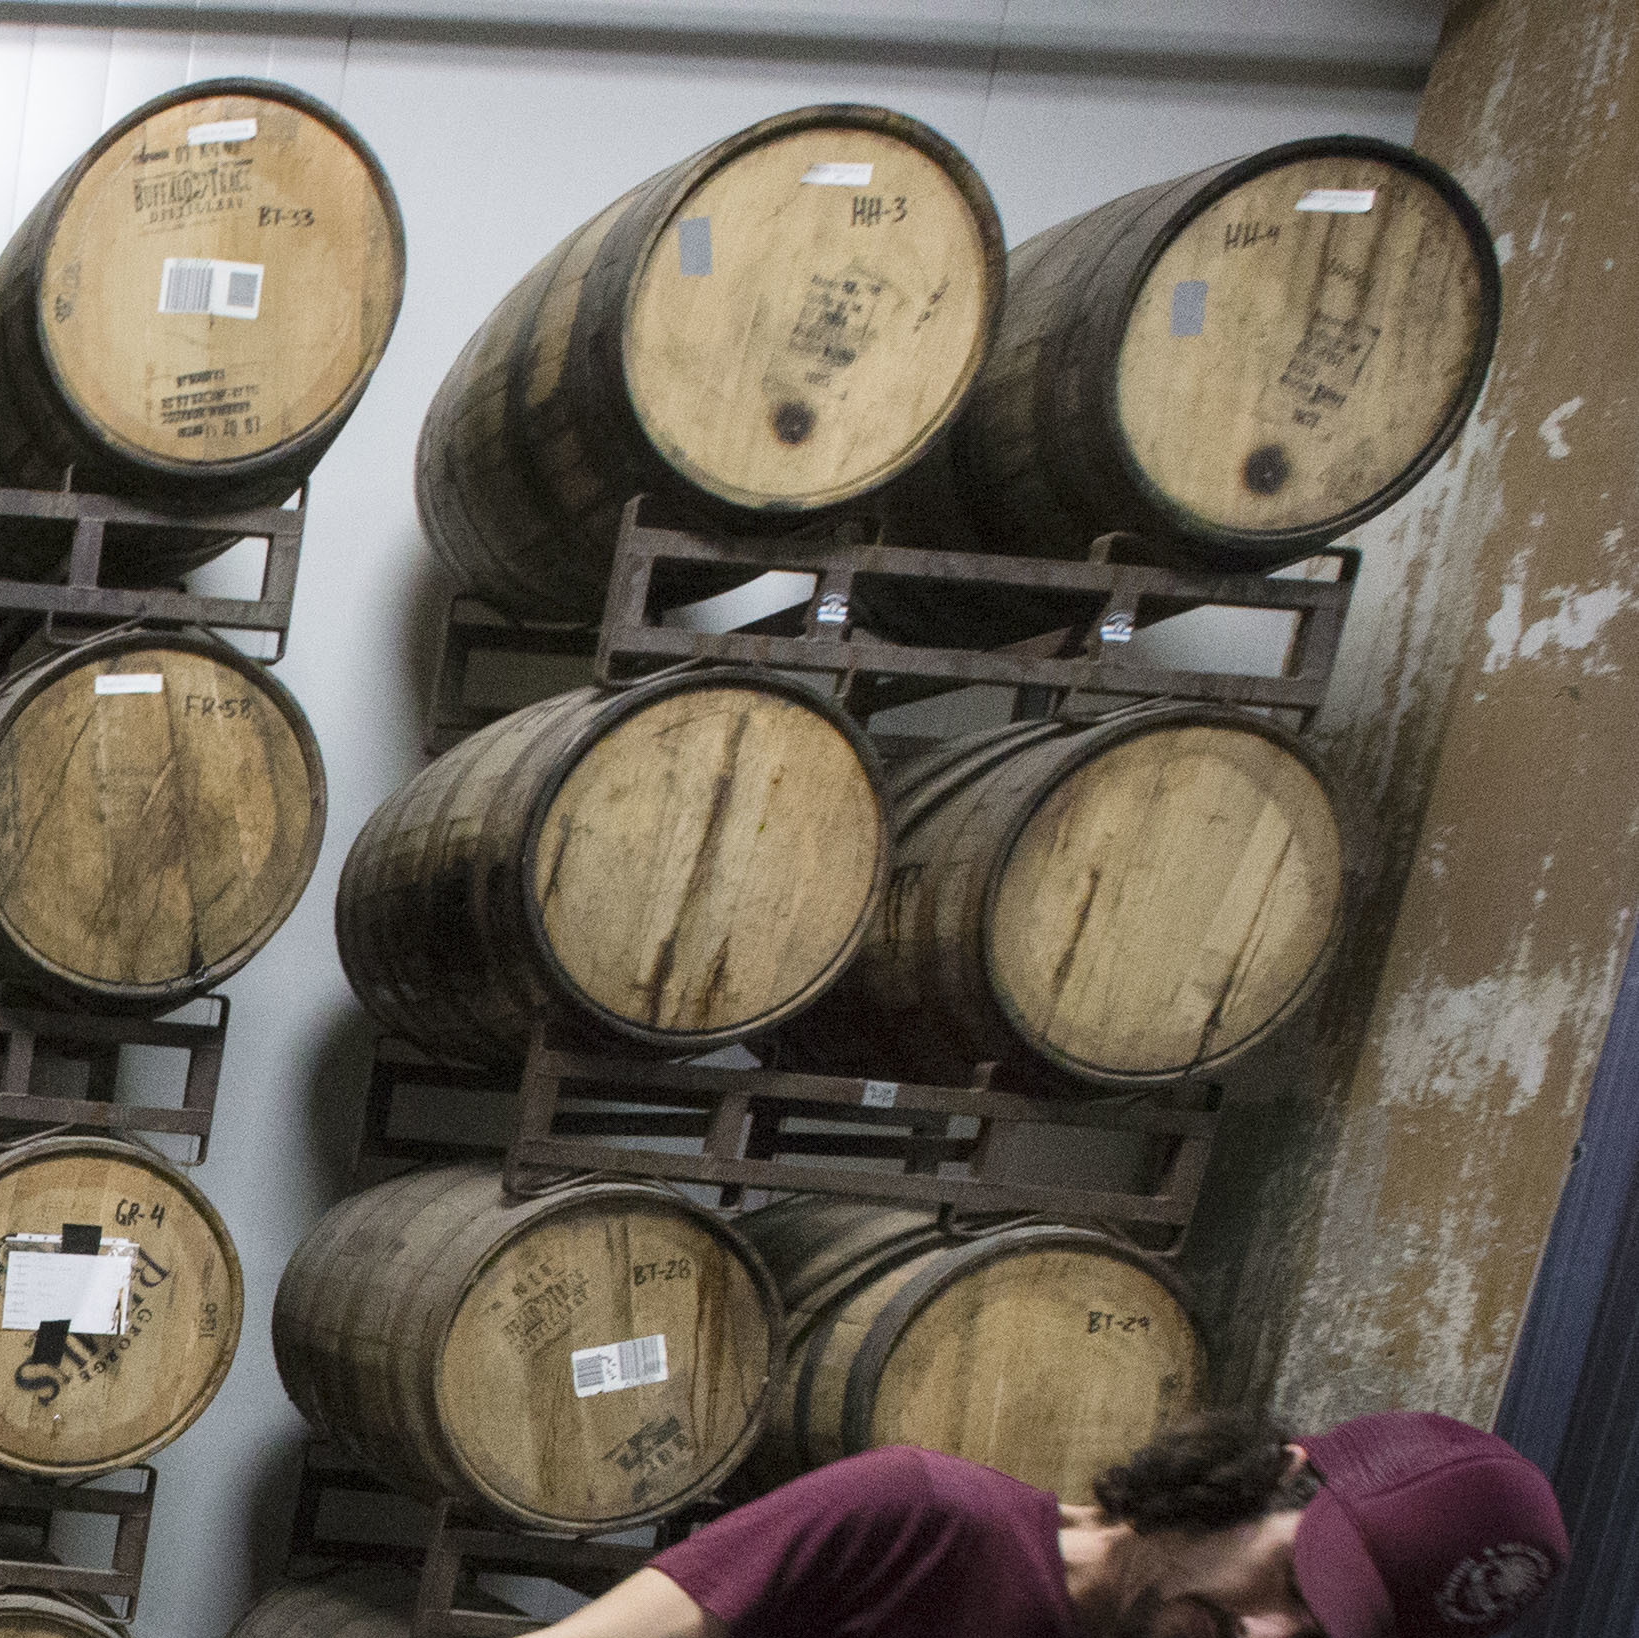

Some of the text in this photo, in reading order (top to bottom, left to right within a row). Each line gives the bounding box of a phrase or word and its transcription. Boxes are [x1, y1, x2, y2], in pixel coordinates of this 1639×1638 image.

[258, 205, 317, 229] BT-33
[849, 195, 909, 226] HH-3
[185, 694, 253, 722] FR-58
[114, 1198, 166, 1230] GR-4
[632, 1257, 692, 1287] BT-28
[74, 1307, 155, 1385] GEORGE
